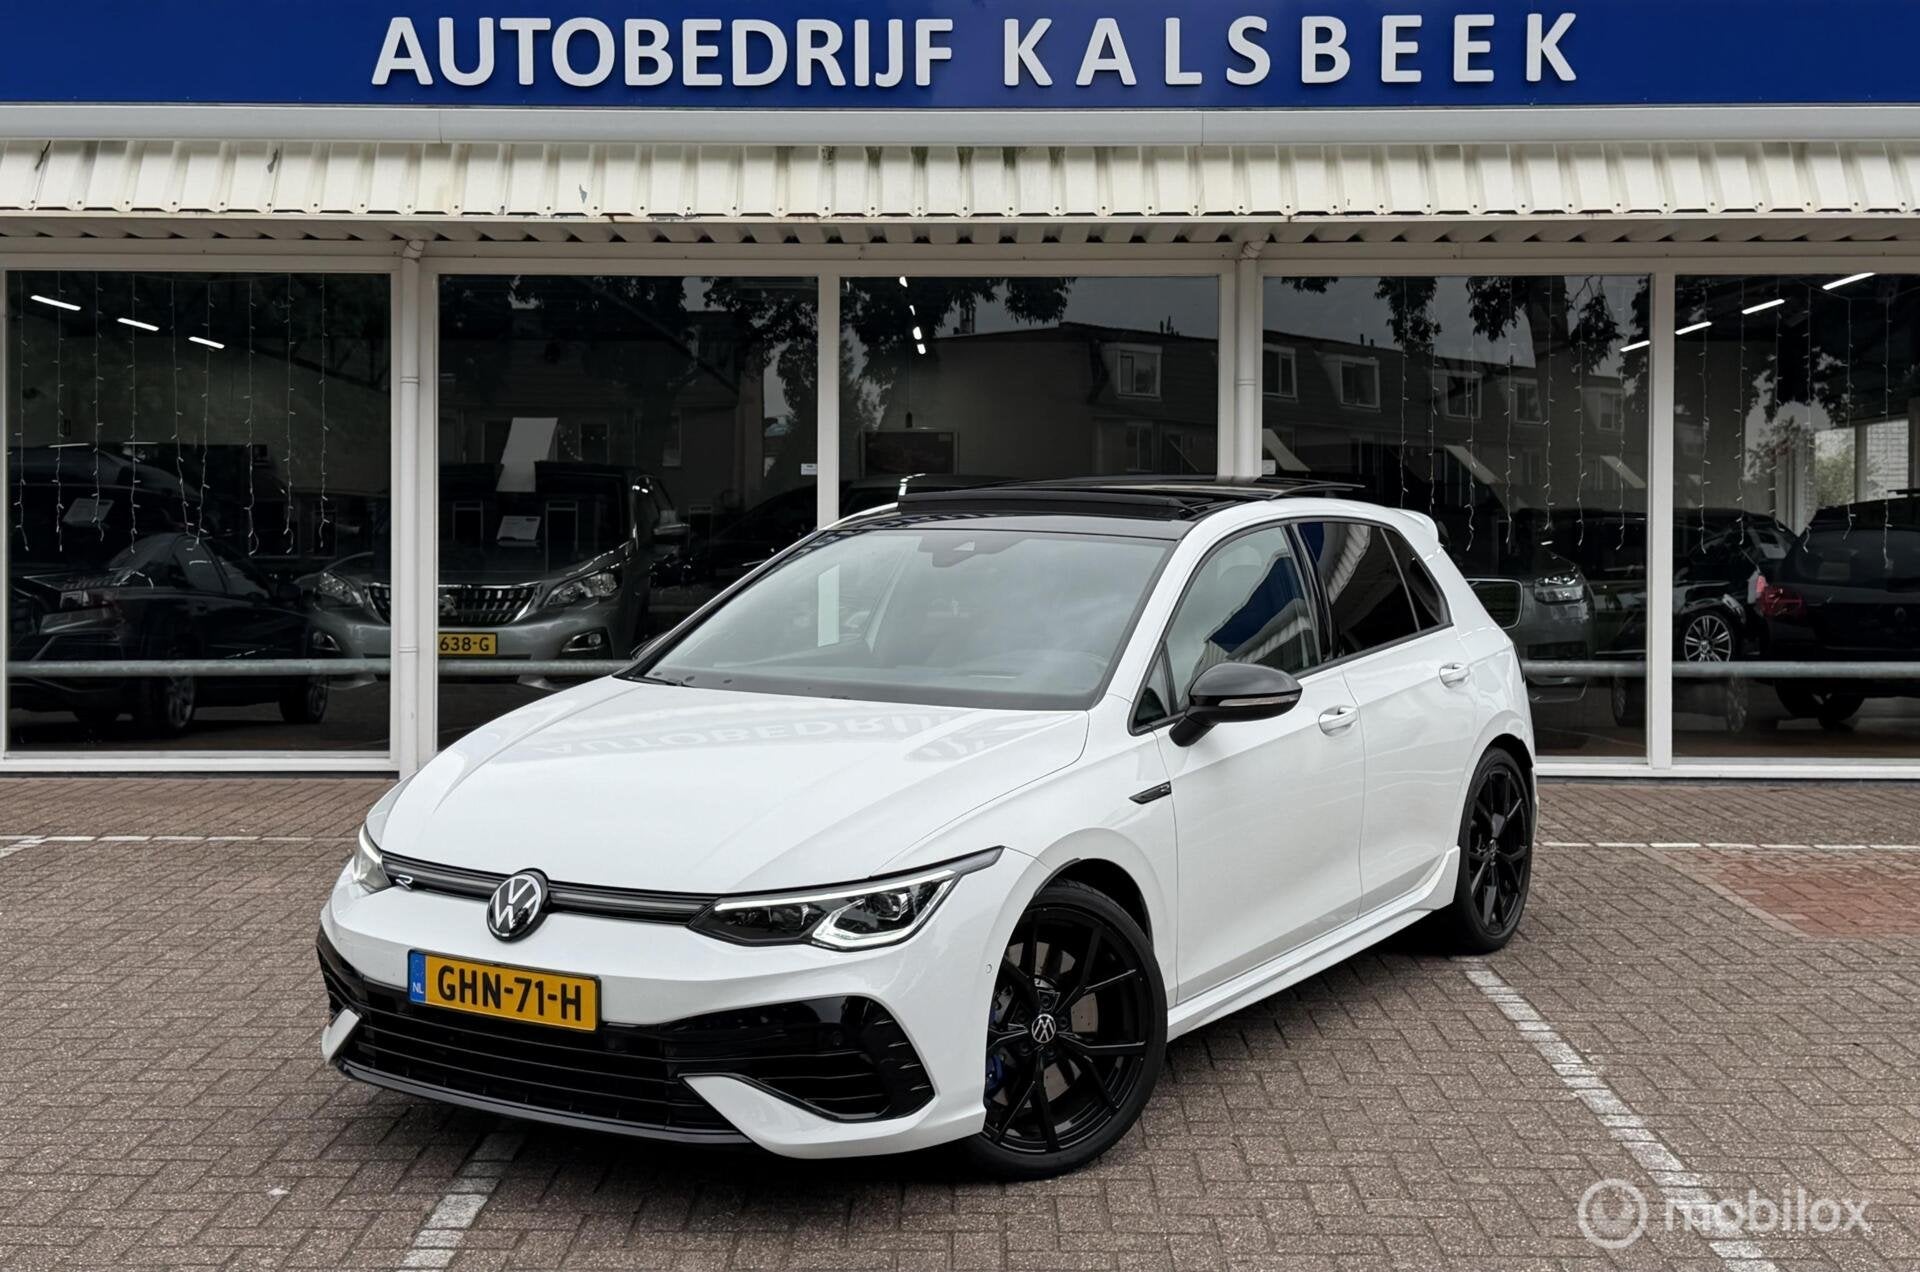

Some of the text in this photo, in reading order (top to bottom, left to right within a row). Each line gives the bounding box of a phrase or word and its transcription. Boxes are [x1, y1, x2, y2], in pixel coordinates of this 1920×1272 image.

[371, 12, 1577, 88] AUTOBEDRIJF KALSBEEK
[412, 981, 424, 994] NL
[437, 964, 582, 1022] GHN-71-H
